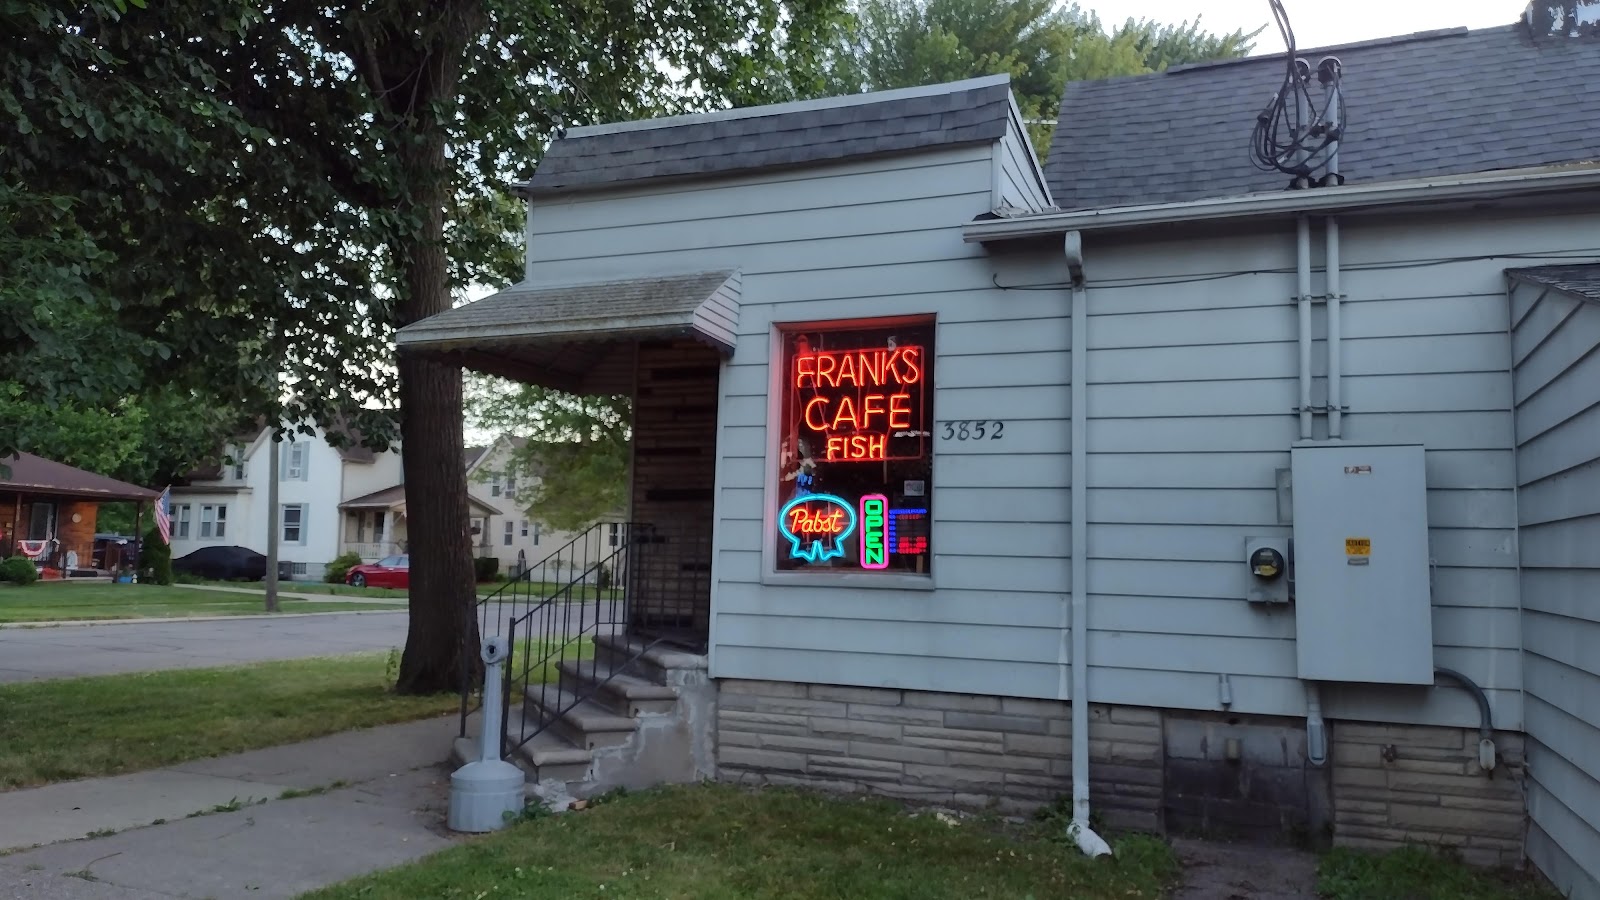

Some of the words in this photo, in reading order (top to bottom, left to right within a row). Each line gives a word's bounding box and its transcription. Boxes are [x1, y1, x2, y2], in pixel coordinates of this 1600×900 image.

[797, 349, 919, 388] FRANKS
[805, 394, 911, 431] CAFE
[941, 420, 1004, 441] 3852
[827, 434, 885, 460] FISH
[789, 508, 844, 533] Pabst
[865, 500, 884, 565] OPEN
